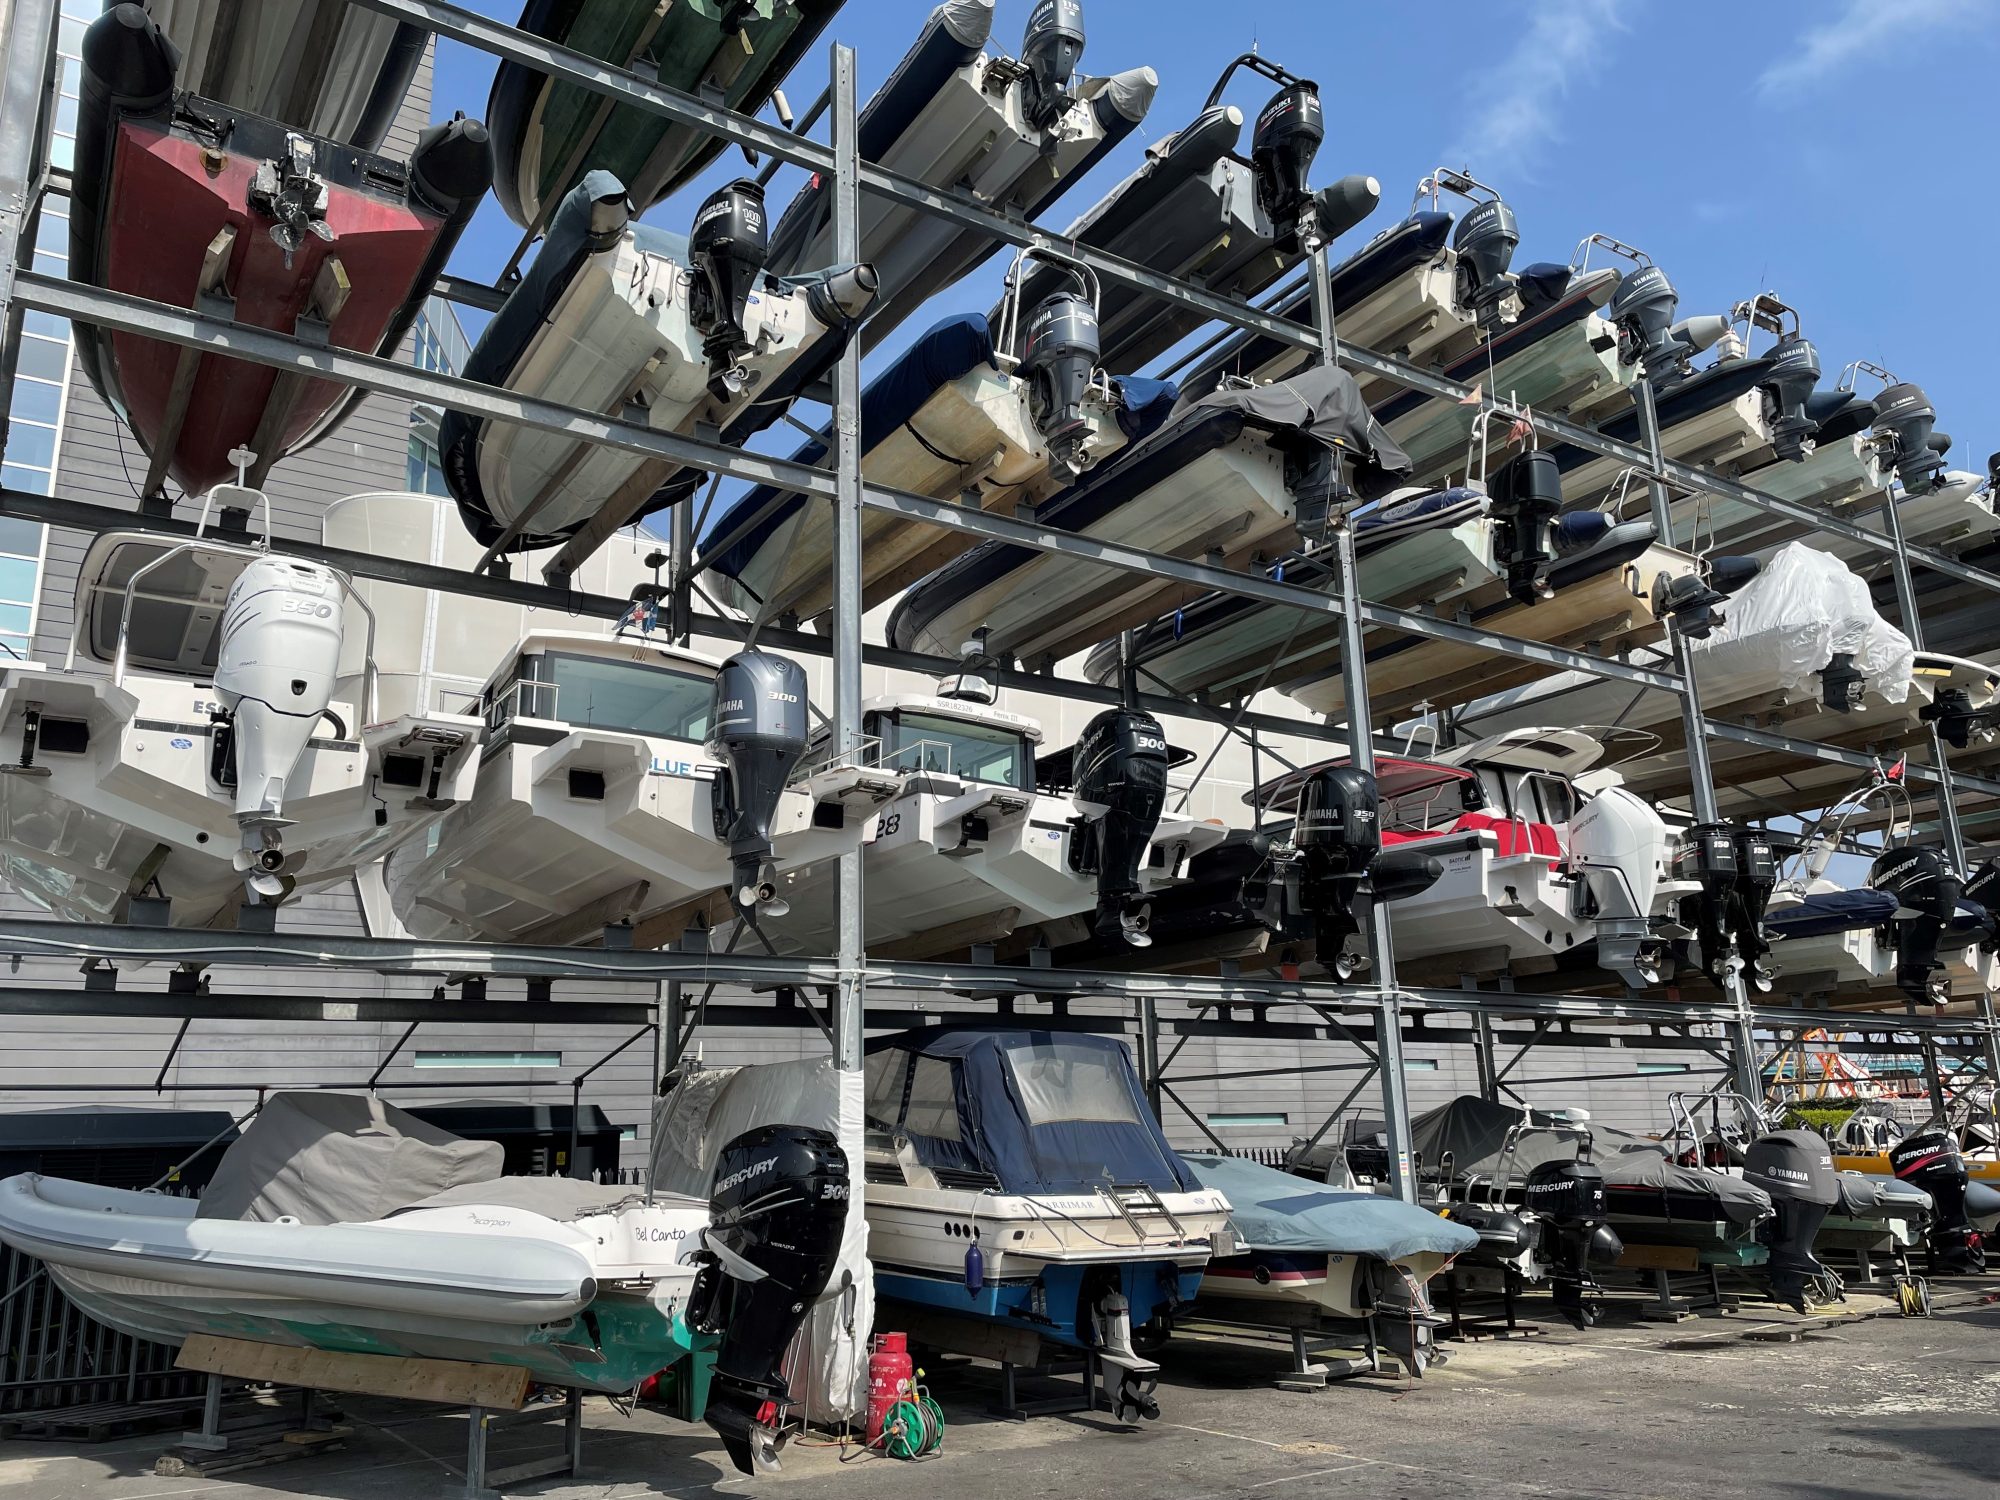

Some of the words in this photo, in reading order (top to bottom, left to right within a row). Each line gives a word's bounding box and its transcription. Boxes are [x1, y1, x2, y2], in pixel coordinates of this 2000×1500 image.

[1031, 1, 1054, 25] YAMAHA
[1260, 96, 1291, 123] SUZUKI
[1469, 208, 1496, 227] YAMAHA
[1632, 271, 1660, 287] YAMAHA
[1031, 310, 1052, 332] YAMAHA
[1779, 347, 1805, 360] YAMAHA
[1896, 395, 1916, 405] YAMAHA
[281, 597, 332, 621] 350
[767, 691, 798, 704] 300
[1137, 736, 1166, 751] 300
[1306, 808, 1339, 820] YAMAHA
[1353, 809, 1375, 818] 350
[876, 814, 901, 839] 28
[1572, 812, 1599, 835] MERCURY
[1674, 841, 1699, 853] SUZUKI
[1713, 840, 1730, 848] 150
[1753, 846, 1769, 855] 150
[1874, 856, 1920, 888] MERCURY
[1965, 871, 1996, 897] MERCURY
[1896, 1145, 1941, 1163] MERCURY
[714, 1156, 780, 1198] MERCURY
[1778, 1170, 1809, 1183] YAMAHA
[820, 1184, 850, 1202] 300
[1527, 1180, 1575, 1193] MERCURY
[1593, 1190, 1603, 1200] 75
[636, 1227, 648, 1242] Bel
[651, 1228, 686, 1243] Canto
[770, 1241, 796, 1252] VERADO
